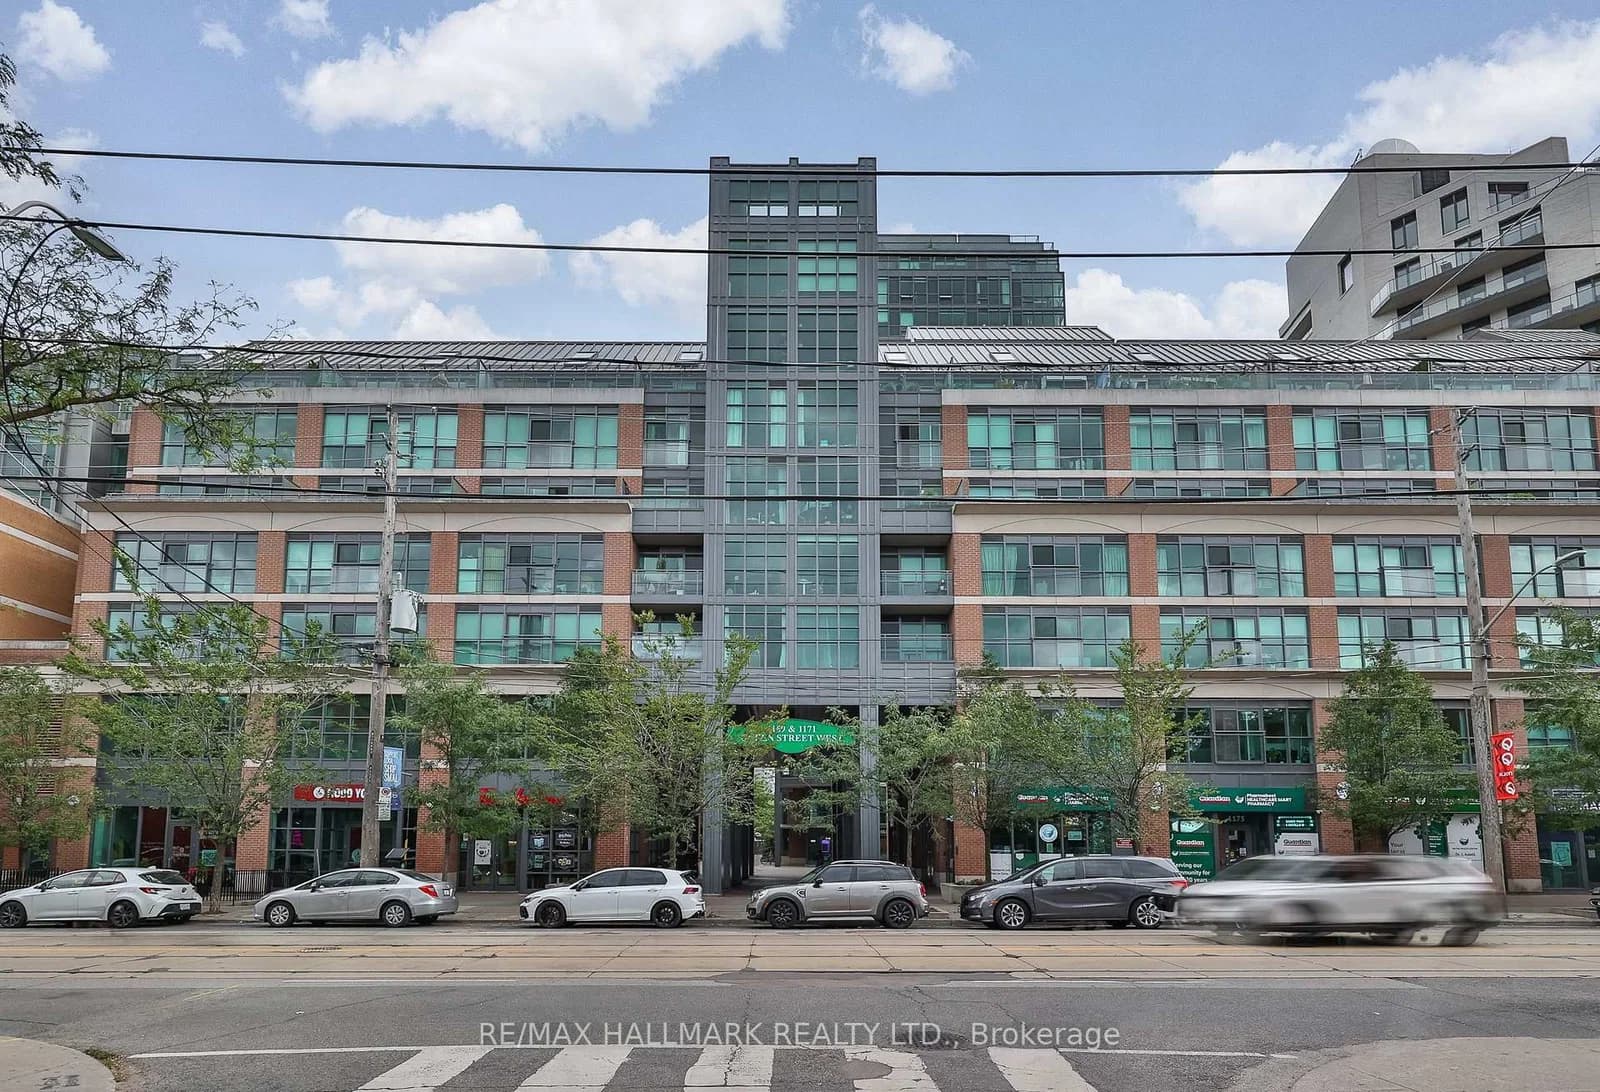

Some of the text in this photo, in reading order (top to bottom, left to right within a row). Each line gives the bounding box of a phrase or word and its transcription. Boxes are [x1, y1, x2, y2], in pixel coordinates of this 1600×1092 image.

[788, 725, 795, 733] &
[800, 725, 816, 733] 1171
[776, 734, 814, 742] STREET
[816, 734, 842, 742] WES
[1199, 795, 1231, 803] Guardian
